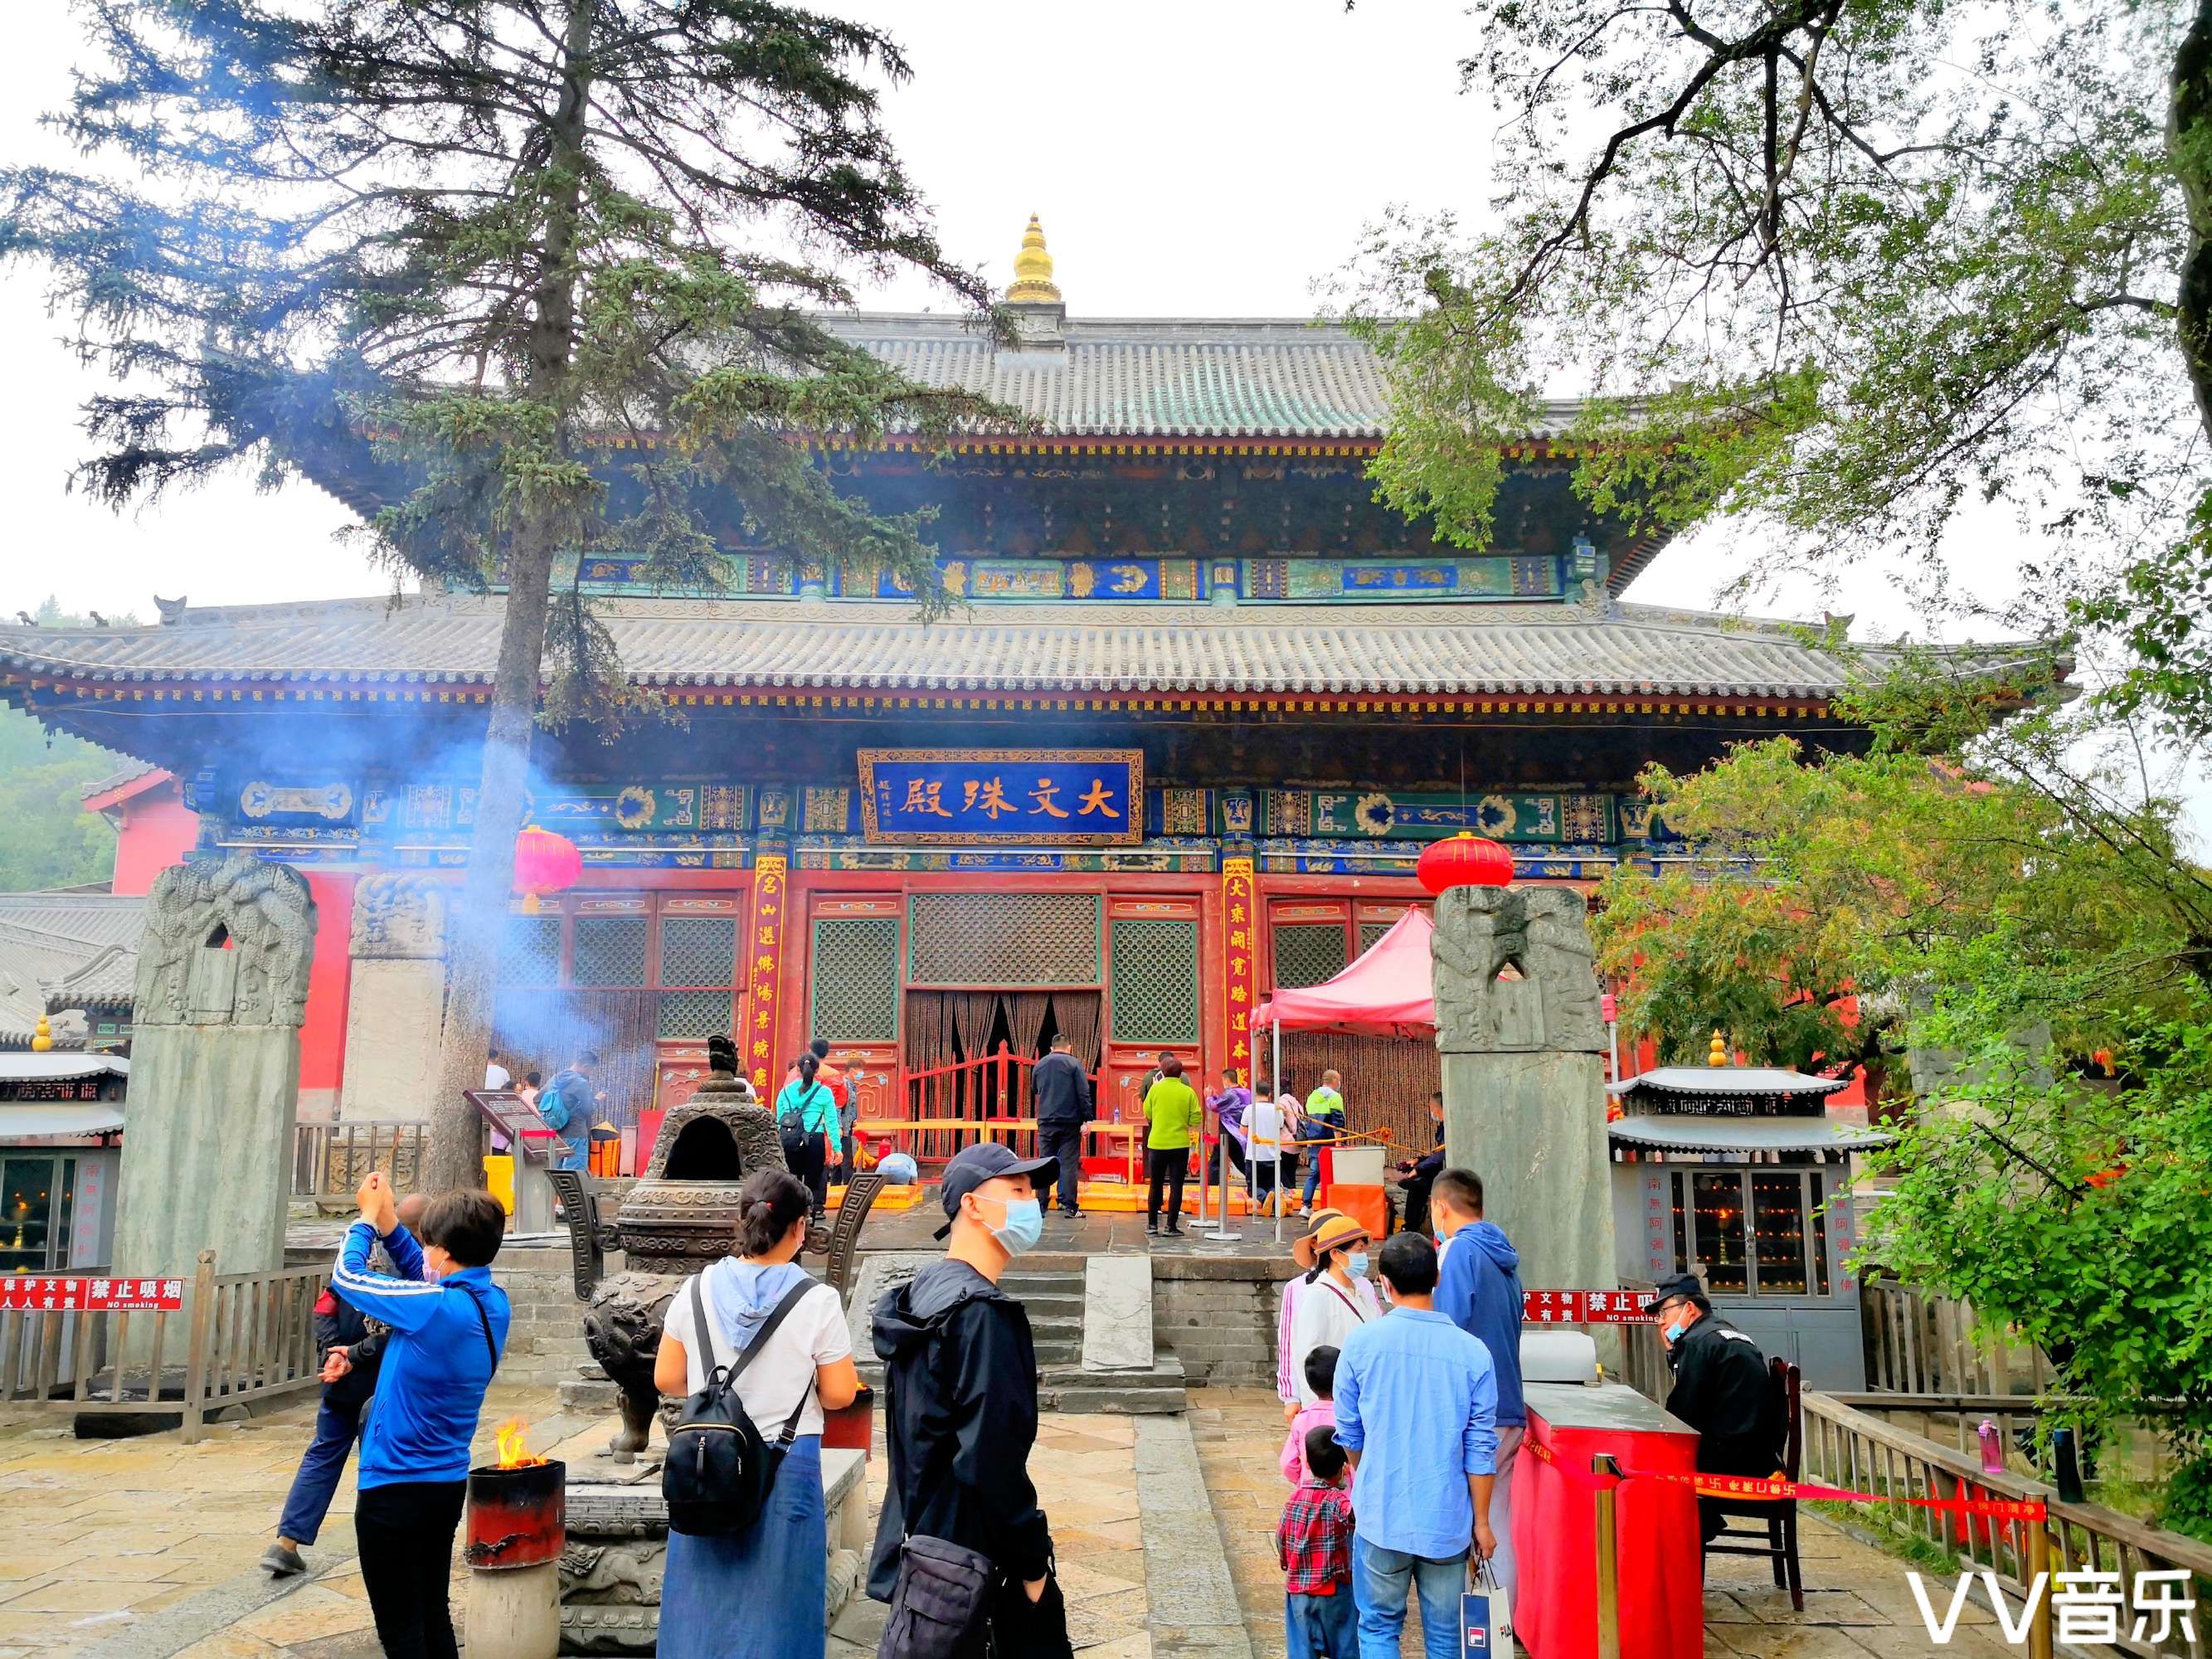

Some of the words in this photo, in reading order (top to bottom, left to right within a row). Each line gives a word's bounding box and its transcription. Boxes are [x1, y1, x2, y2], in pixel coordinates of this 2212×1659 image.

[3, 1280, 78, 1292] 保护文物
[91, 1280, 182, 1299] 禁止吸烟
[2, 1297, 75, 1309] 人人有责
[123, 1301, 158, 1310] smoking
